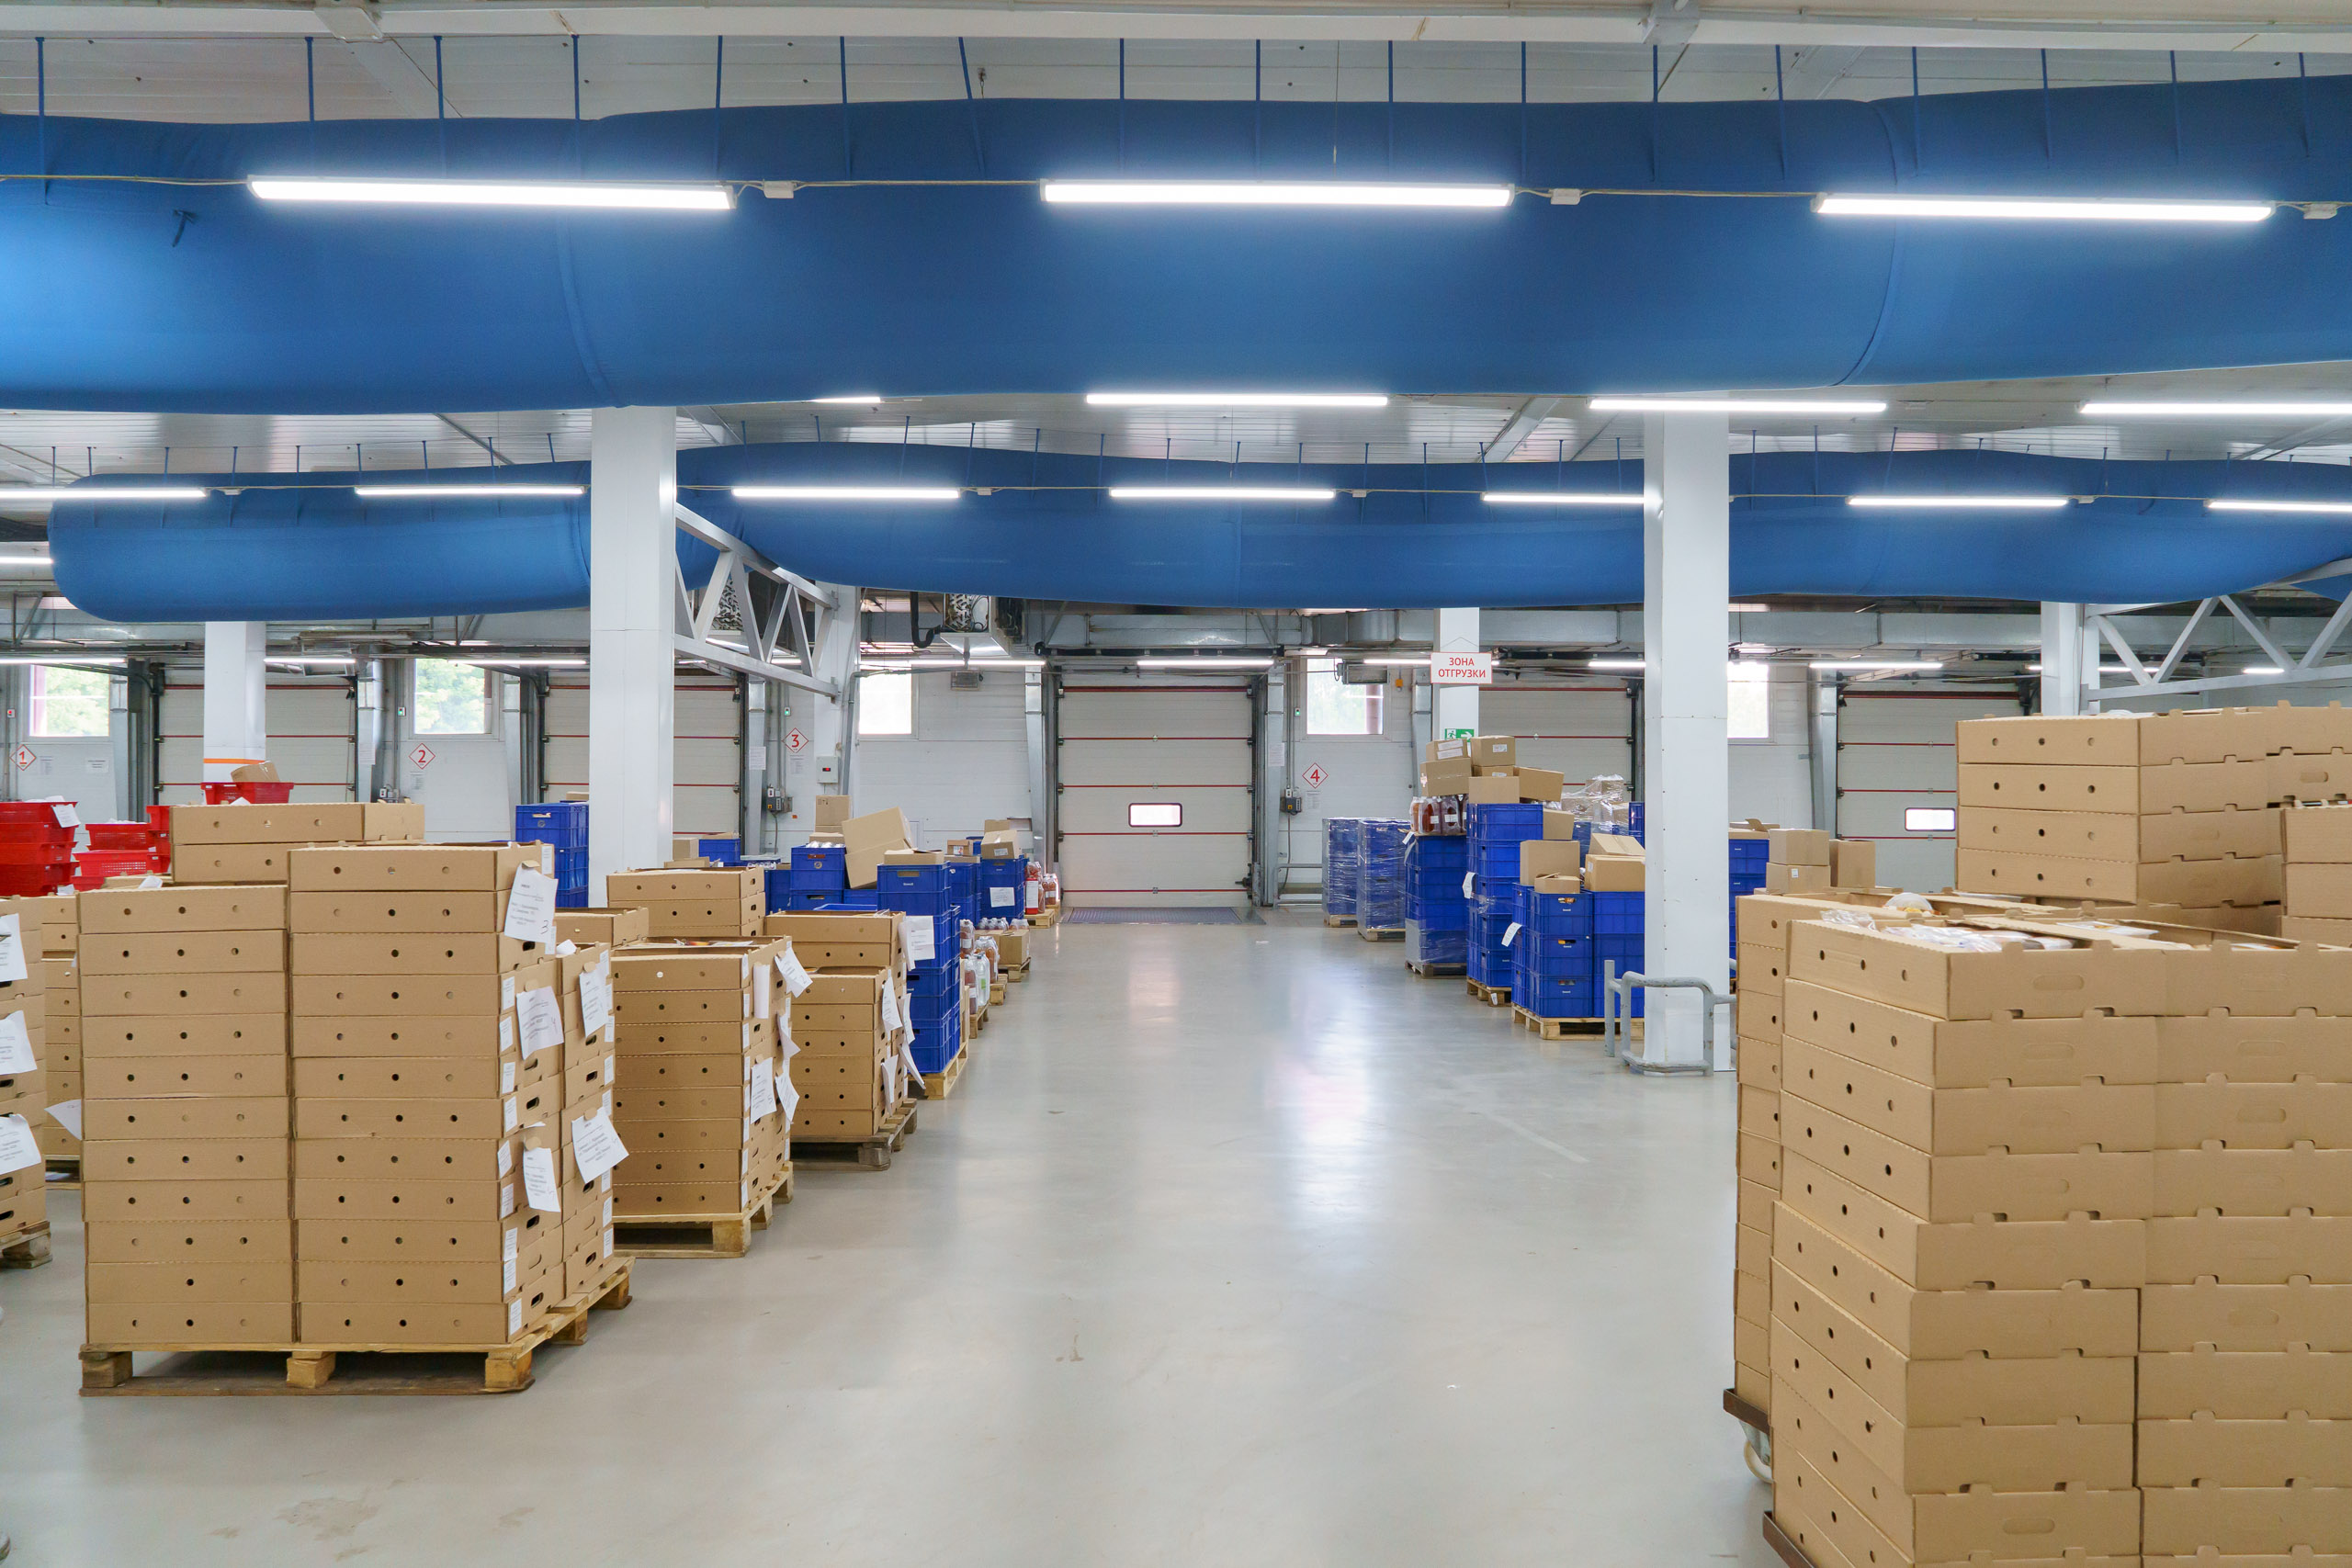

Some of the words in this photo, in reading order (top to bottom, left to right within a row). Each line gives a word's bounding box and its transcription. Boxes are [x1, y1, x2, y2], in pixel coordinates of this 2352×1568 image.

[1449, 657, 1475, 666] ЗОНА
[1438, 669, 1486, 678] ОТГРУЗКИ
[791, 734, 799, 748] 3
[18, 750, 28, 765] 1
[418, 750, 426, 763] 2
[1310, 769, 1320, 783] 4
[540, 919, 549, 935] 3
